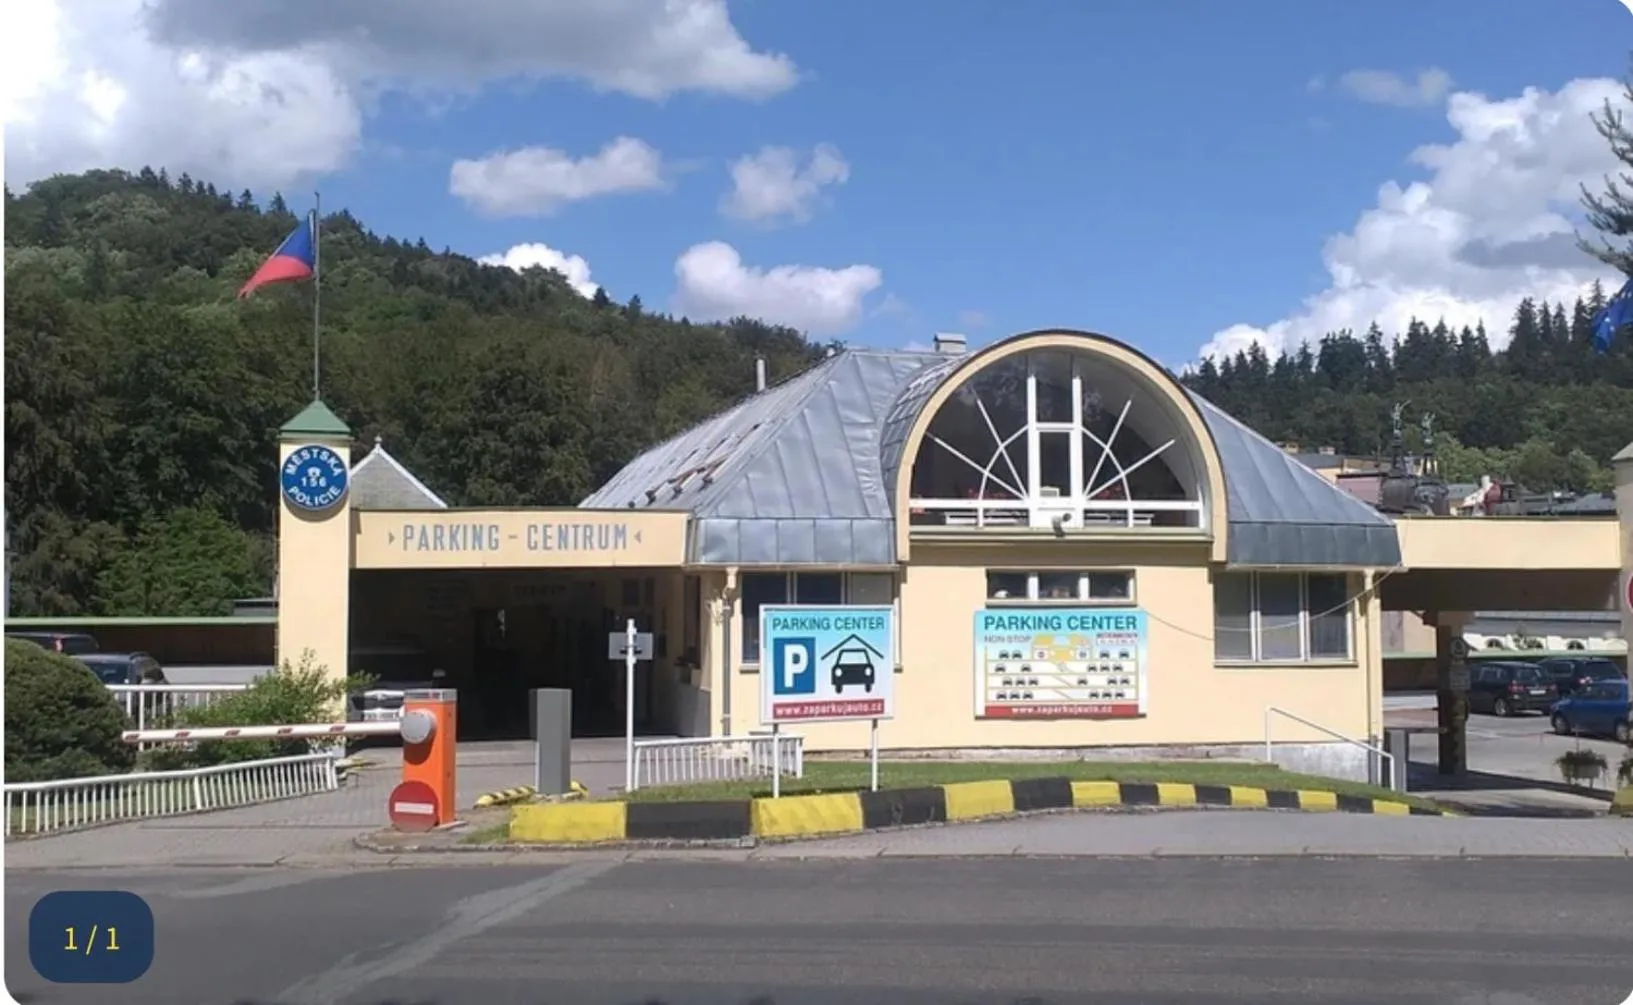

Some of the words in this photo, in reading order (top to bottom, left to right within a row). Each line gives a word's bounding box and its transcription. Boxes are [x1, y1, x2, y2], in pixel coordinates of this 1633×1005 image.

[288, 486, 341, 506] POLICIE
[403, 524, 499, 551] PARKING
[527, 523, 628, 550] CENTRUM
[773, 618, 830, 630] PARKING
[834, 617, 885, 630] CENTER
[984, 616, 1062, 630] PARKING
[1067, 616, 1137, 630] CENTER
